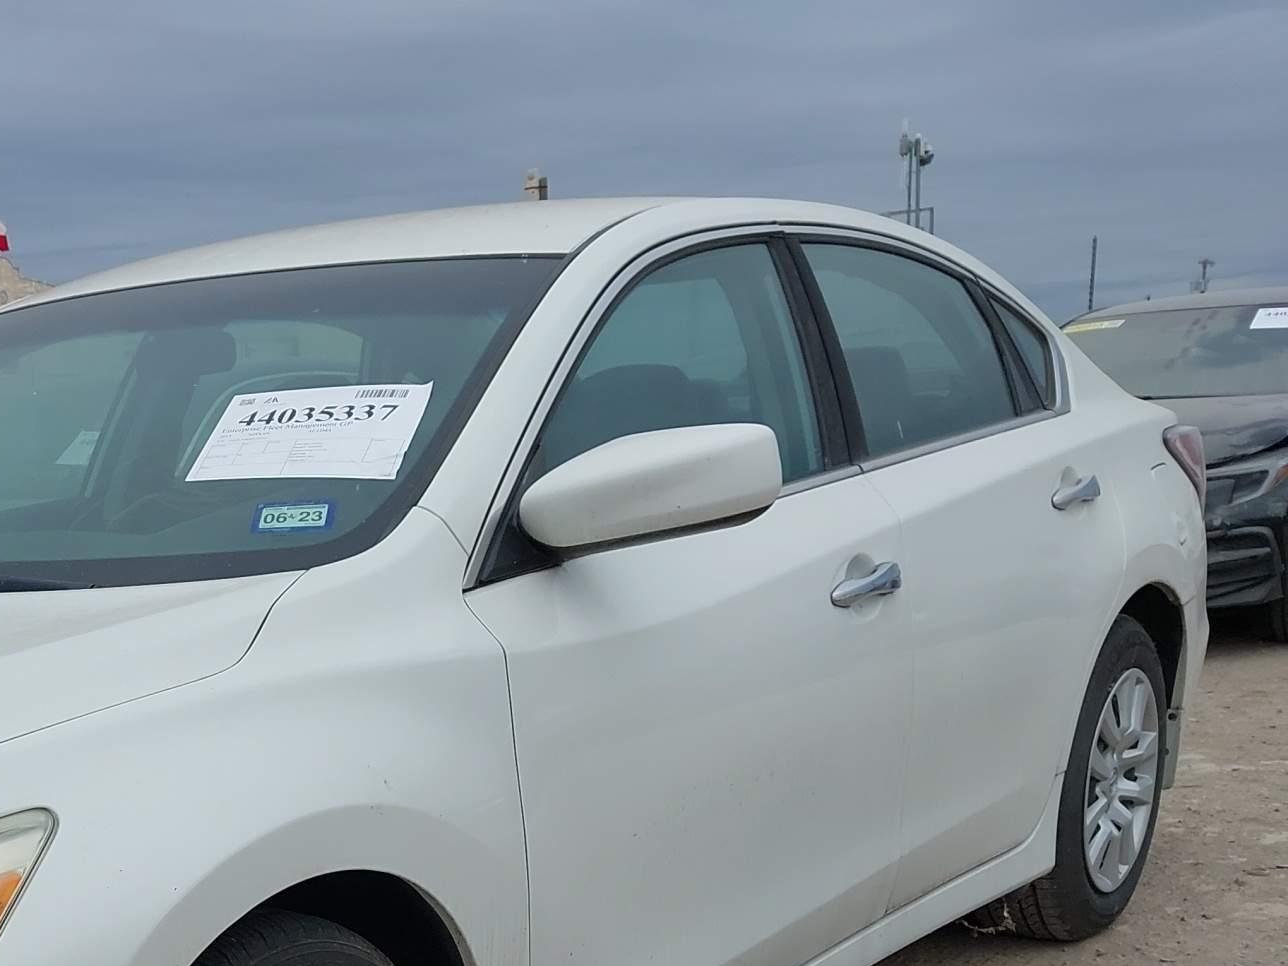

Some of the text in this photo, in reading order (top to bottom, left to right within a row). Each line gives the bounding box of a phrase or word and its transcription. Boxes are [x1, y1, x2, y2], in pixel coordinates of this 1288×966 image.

[238, 404, 399, 426] 44035337
[263, 510, 323, 524] 06 23
